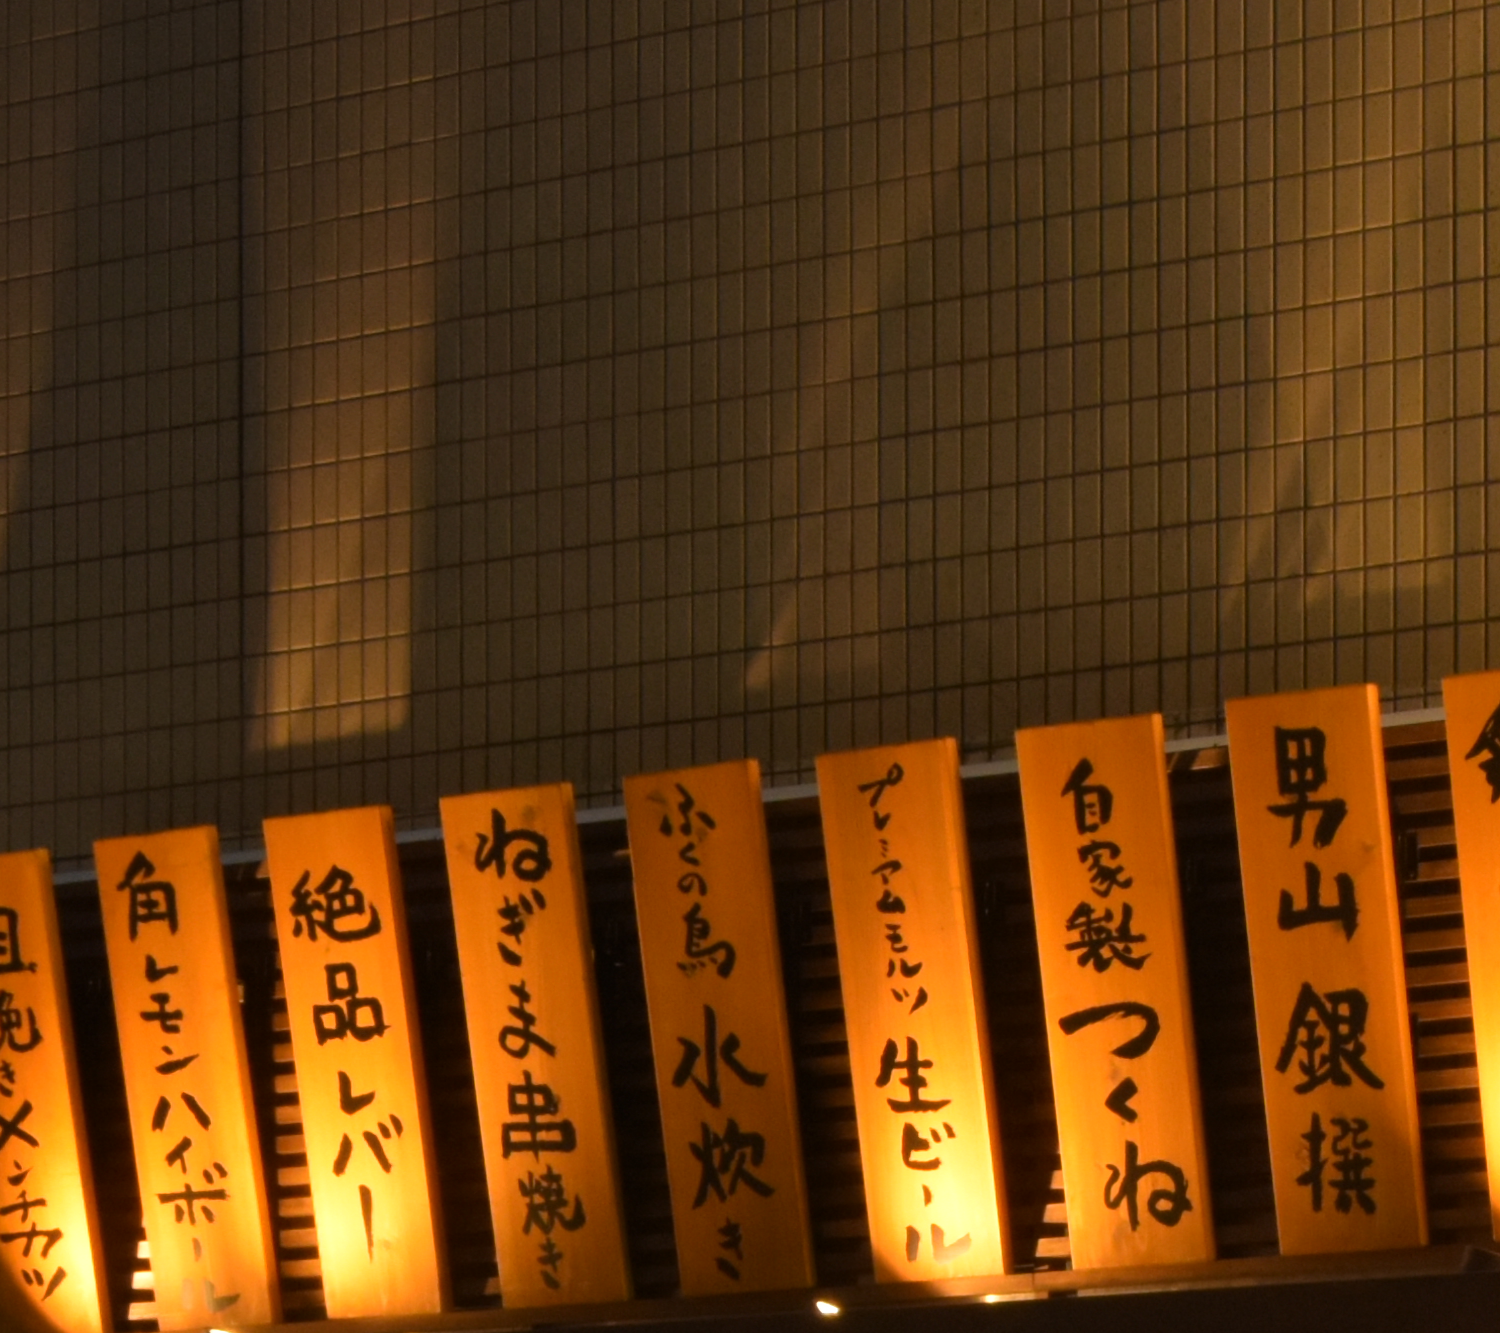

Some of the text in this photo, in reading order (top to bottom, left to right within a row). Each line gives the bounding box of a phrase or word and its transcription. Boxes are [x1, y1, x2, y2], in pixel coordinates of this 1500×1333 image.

[289, 865, 403, 1263] 絶品レバー
[474, 809, 586, 1291] ねぎま串焼き
